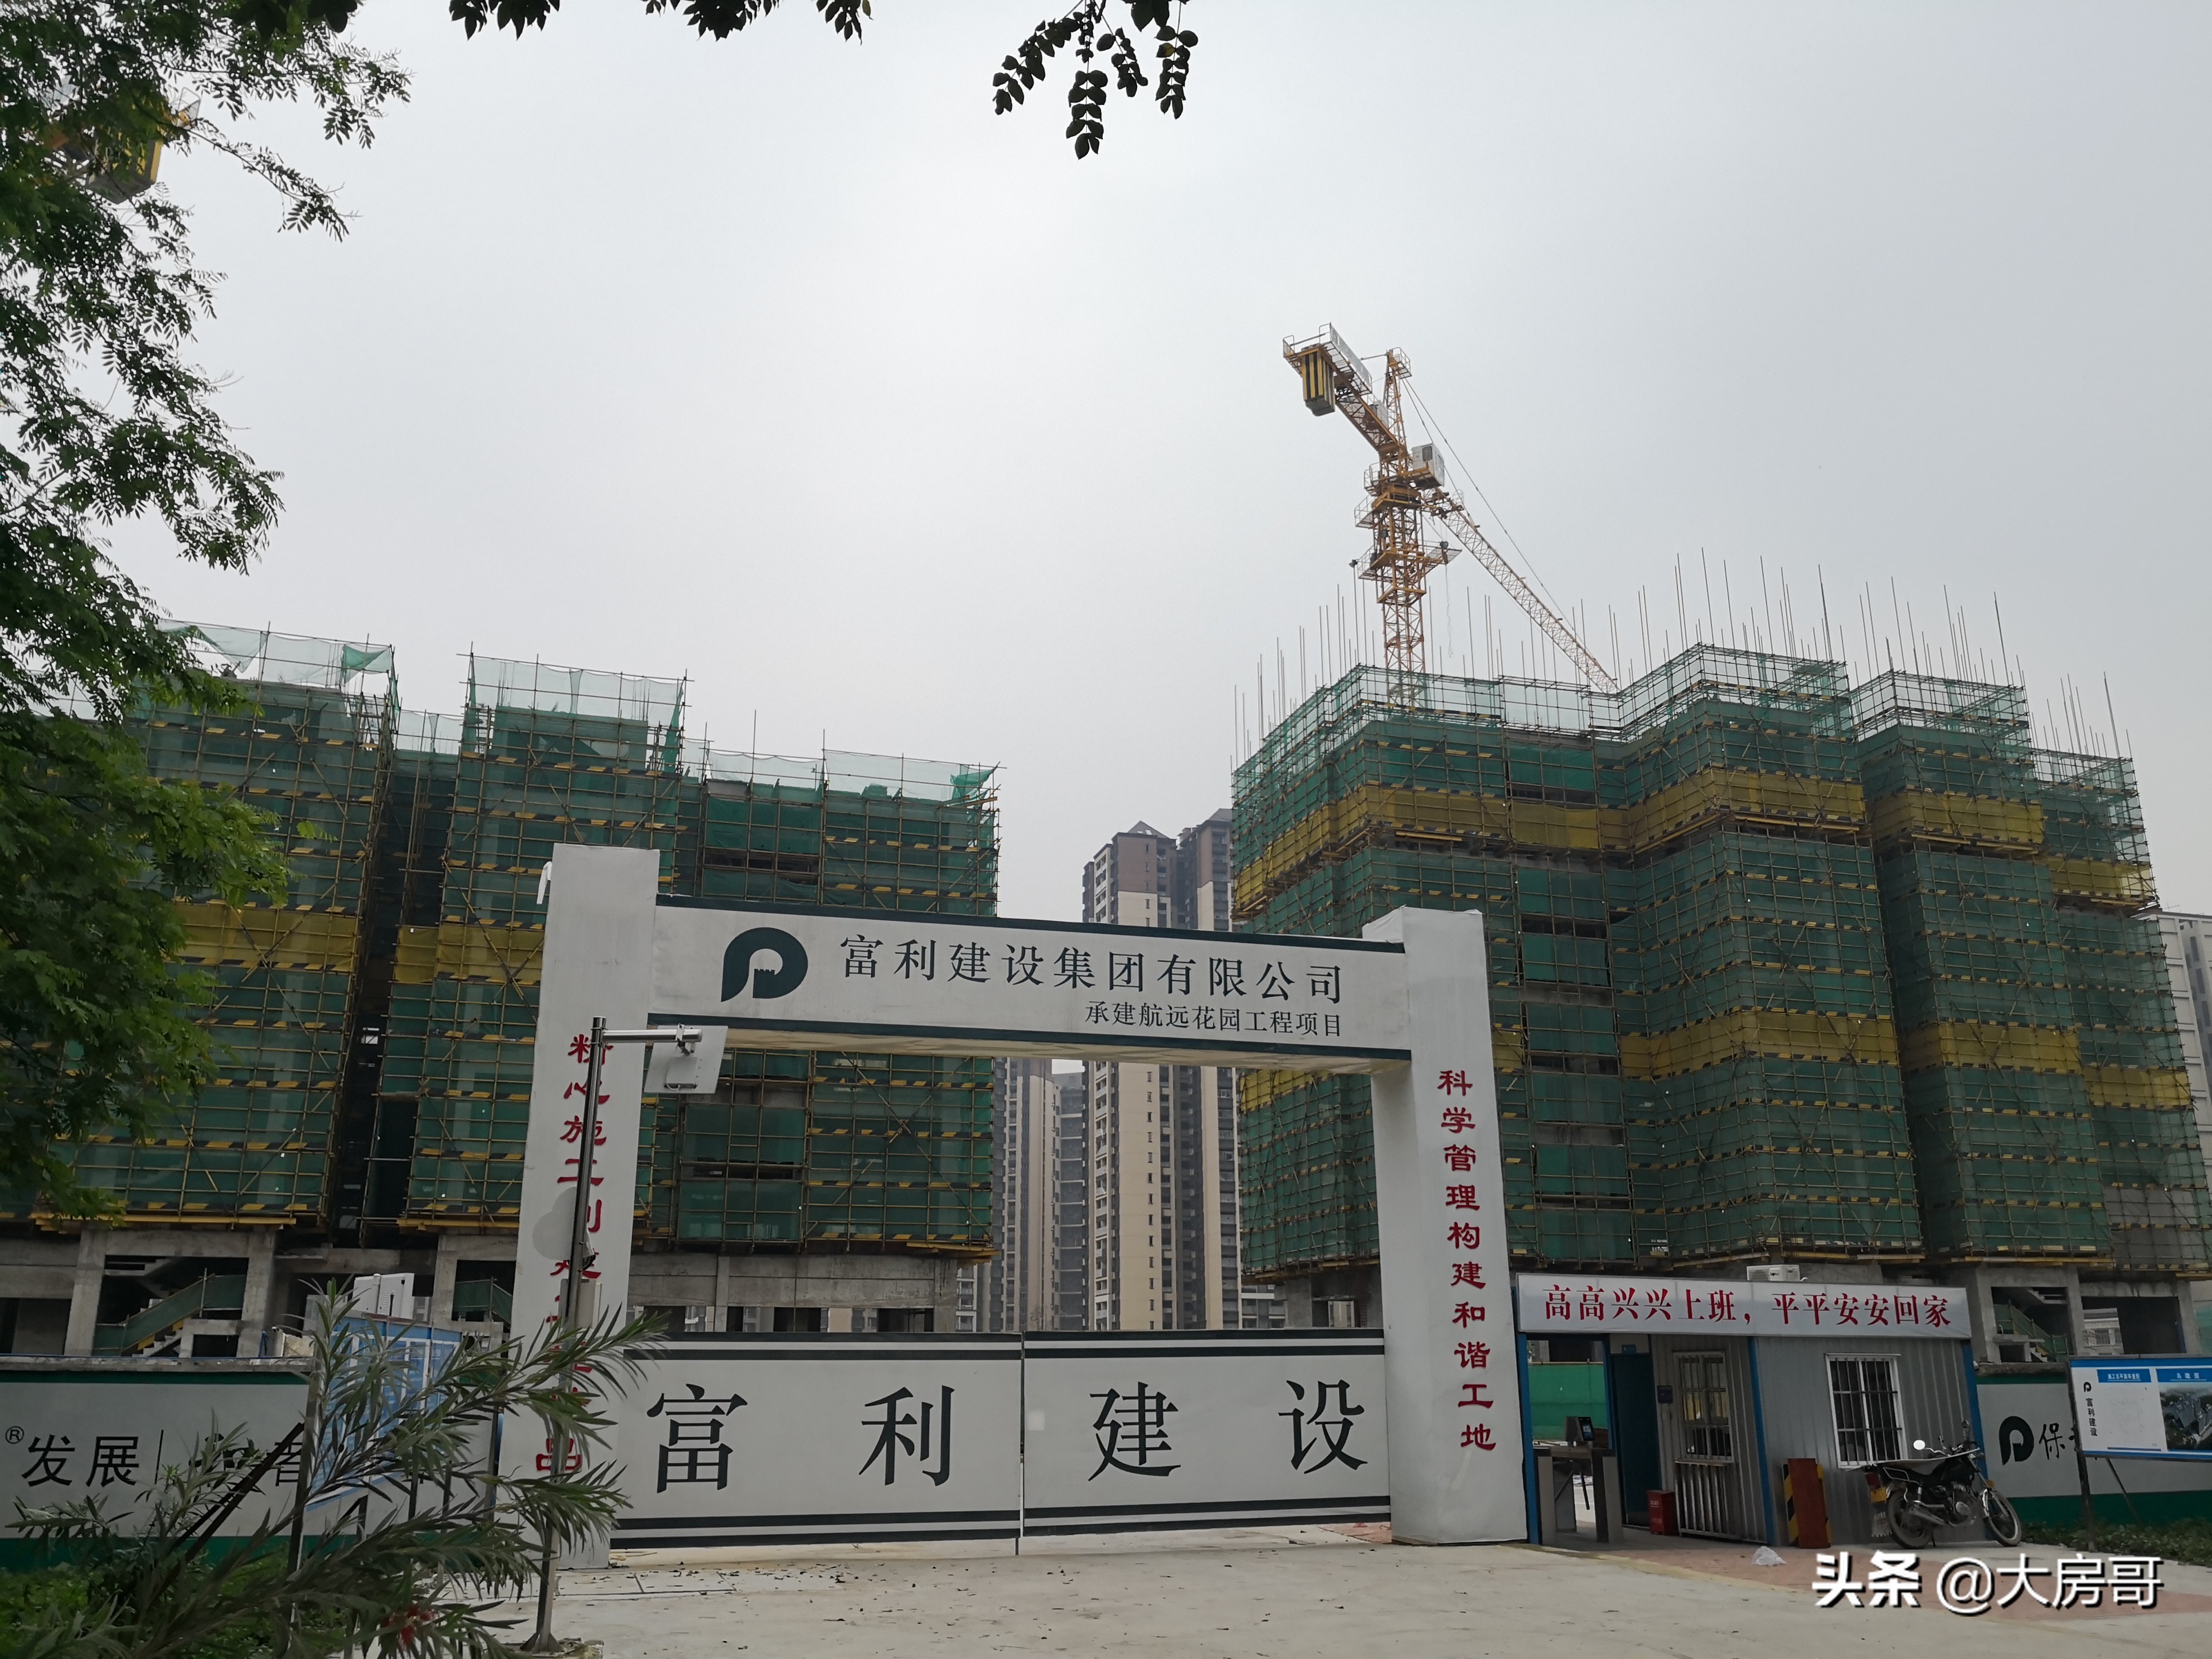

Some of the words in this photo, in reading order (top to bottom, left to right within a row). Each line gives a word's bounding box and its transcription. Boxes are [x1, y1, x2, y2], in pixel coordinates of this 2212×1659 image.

[840, 934, 1341, 1005] 富利建设集团有限公司
[1085, 1000, 1341, 1037] 承建航远花园工程项目
[1437, 1069, 1497, 1451] 科学管理构建和谐工地
[21, 1434, 139, 1487] 发展
[647, 1379, 1368, 1493] 富利建设
